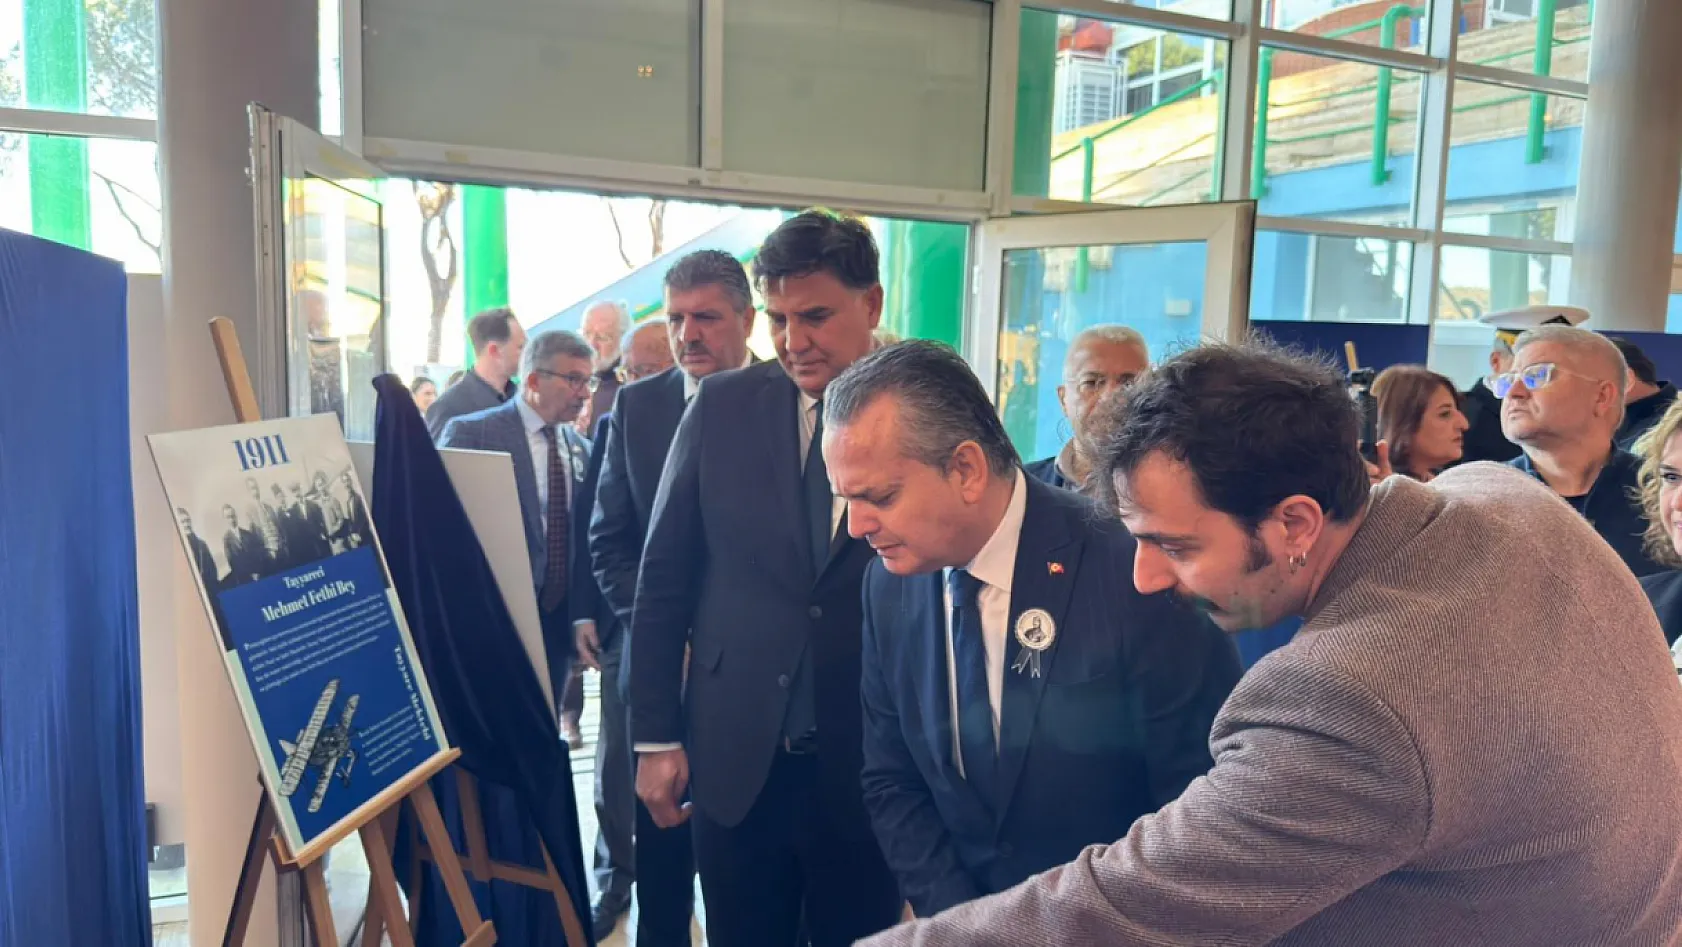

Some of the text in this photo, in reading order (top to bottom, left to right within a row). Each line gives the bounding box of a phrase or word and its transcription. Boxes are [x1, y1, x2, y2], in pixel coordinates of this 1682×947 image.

[231, 433, 291, 471] 1911
[261, 579, 356, 622] Mehmet Fethi Bey
